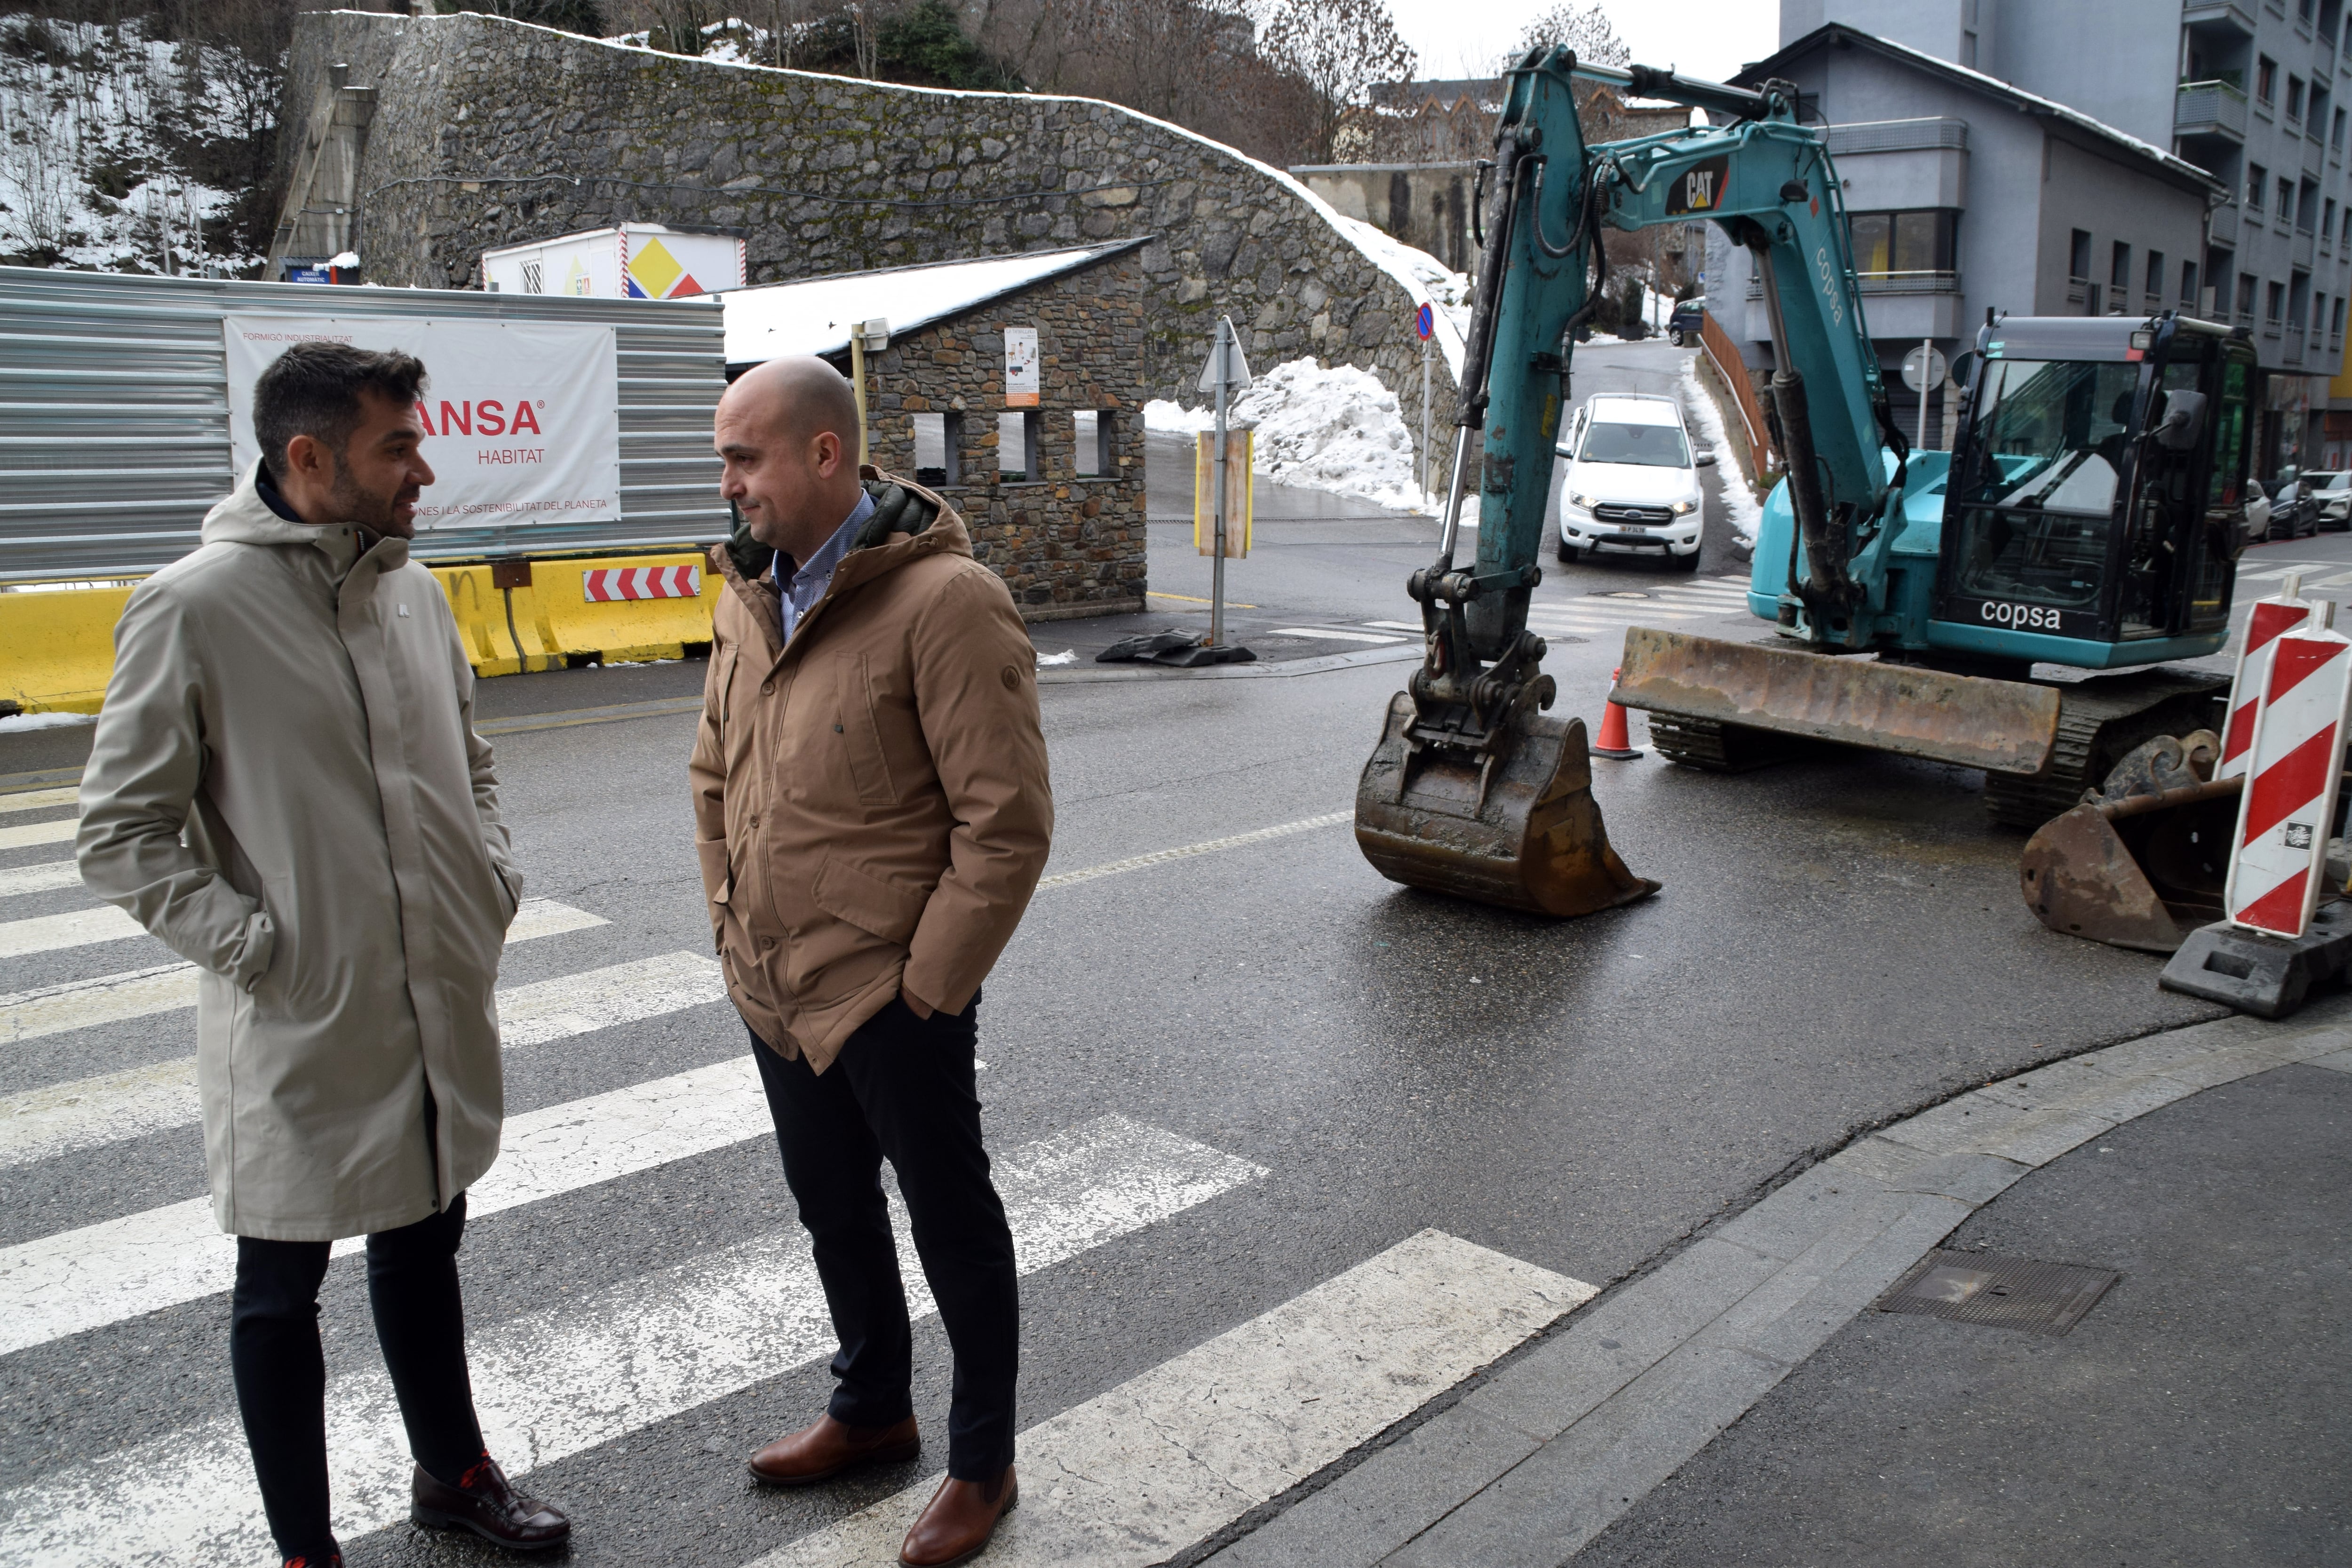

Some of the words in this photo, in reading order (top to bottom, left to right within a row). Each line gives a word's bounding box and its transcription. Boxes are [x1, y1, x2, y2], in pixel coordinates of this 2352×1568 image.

[1686, 171, 1713, 208] CAT
[1817, 247, 1843, 327] copsa
[243, 332, 282, 341] FORMIGÓ
[285, 333, 353, 342] INDUSTRIALITZAT
[478, 449, 545, 464] HABITAT
[417, 506, 439, 516] NES
[442, 506, 444, 515] I
[447, 505, 460, 514] LA
[462, 502, 542, 514] SOSTENIBILITAT
[544, 501, 562, 510] DEL
[564, 499, 607, 509] PLANETA
[1981, 601, 2061, 629] copsa
